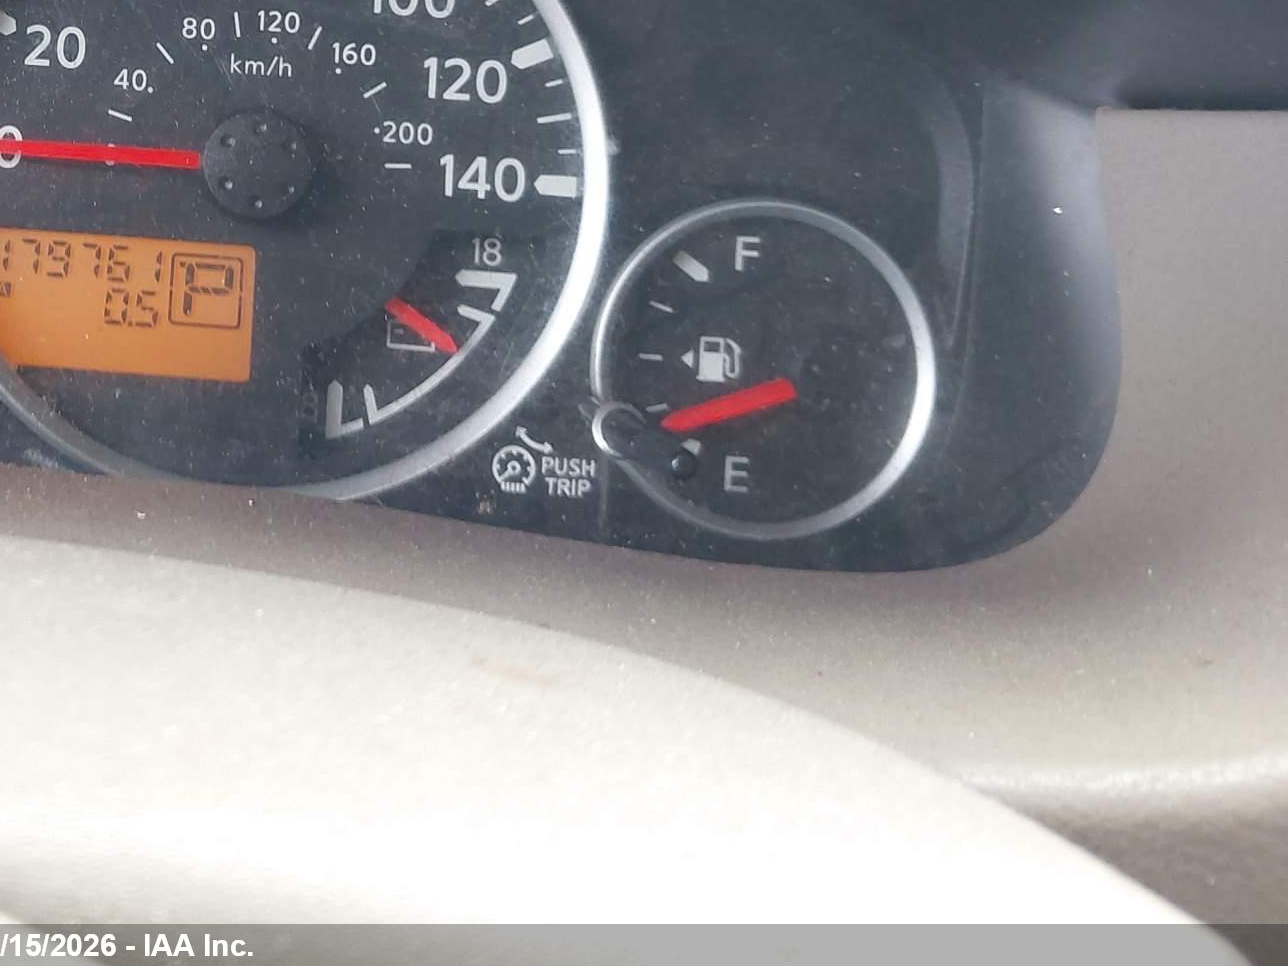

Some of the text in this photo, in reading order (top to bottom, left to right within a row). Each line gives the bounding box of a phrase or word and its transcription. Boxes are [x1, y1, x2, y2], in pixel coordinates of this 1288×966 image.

[182, 17, 216, 41] 80
[257, 9, 300, 35] 120
[24, 24, 86, 69] 20
[332, 42, 376, 67] 160
[230, 52, 293, 79] km/h
[113, 68, 145, 92] 40
[423, 56, 508, 104] 120
[382, 120, 434, 146] 200
[439, 153, 526, 204] 140
[471, 237, 503, 267] 18
[734, 235, 761, 272] F
[180, 261, 235, 316] P
[103, 287, 159, 328] 0.5
[541, 456, 596, 478] PUSH
[723, 455, 750, 493] E
[544, 476, 591, 497] TRIP
